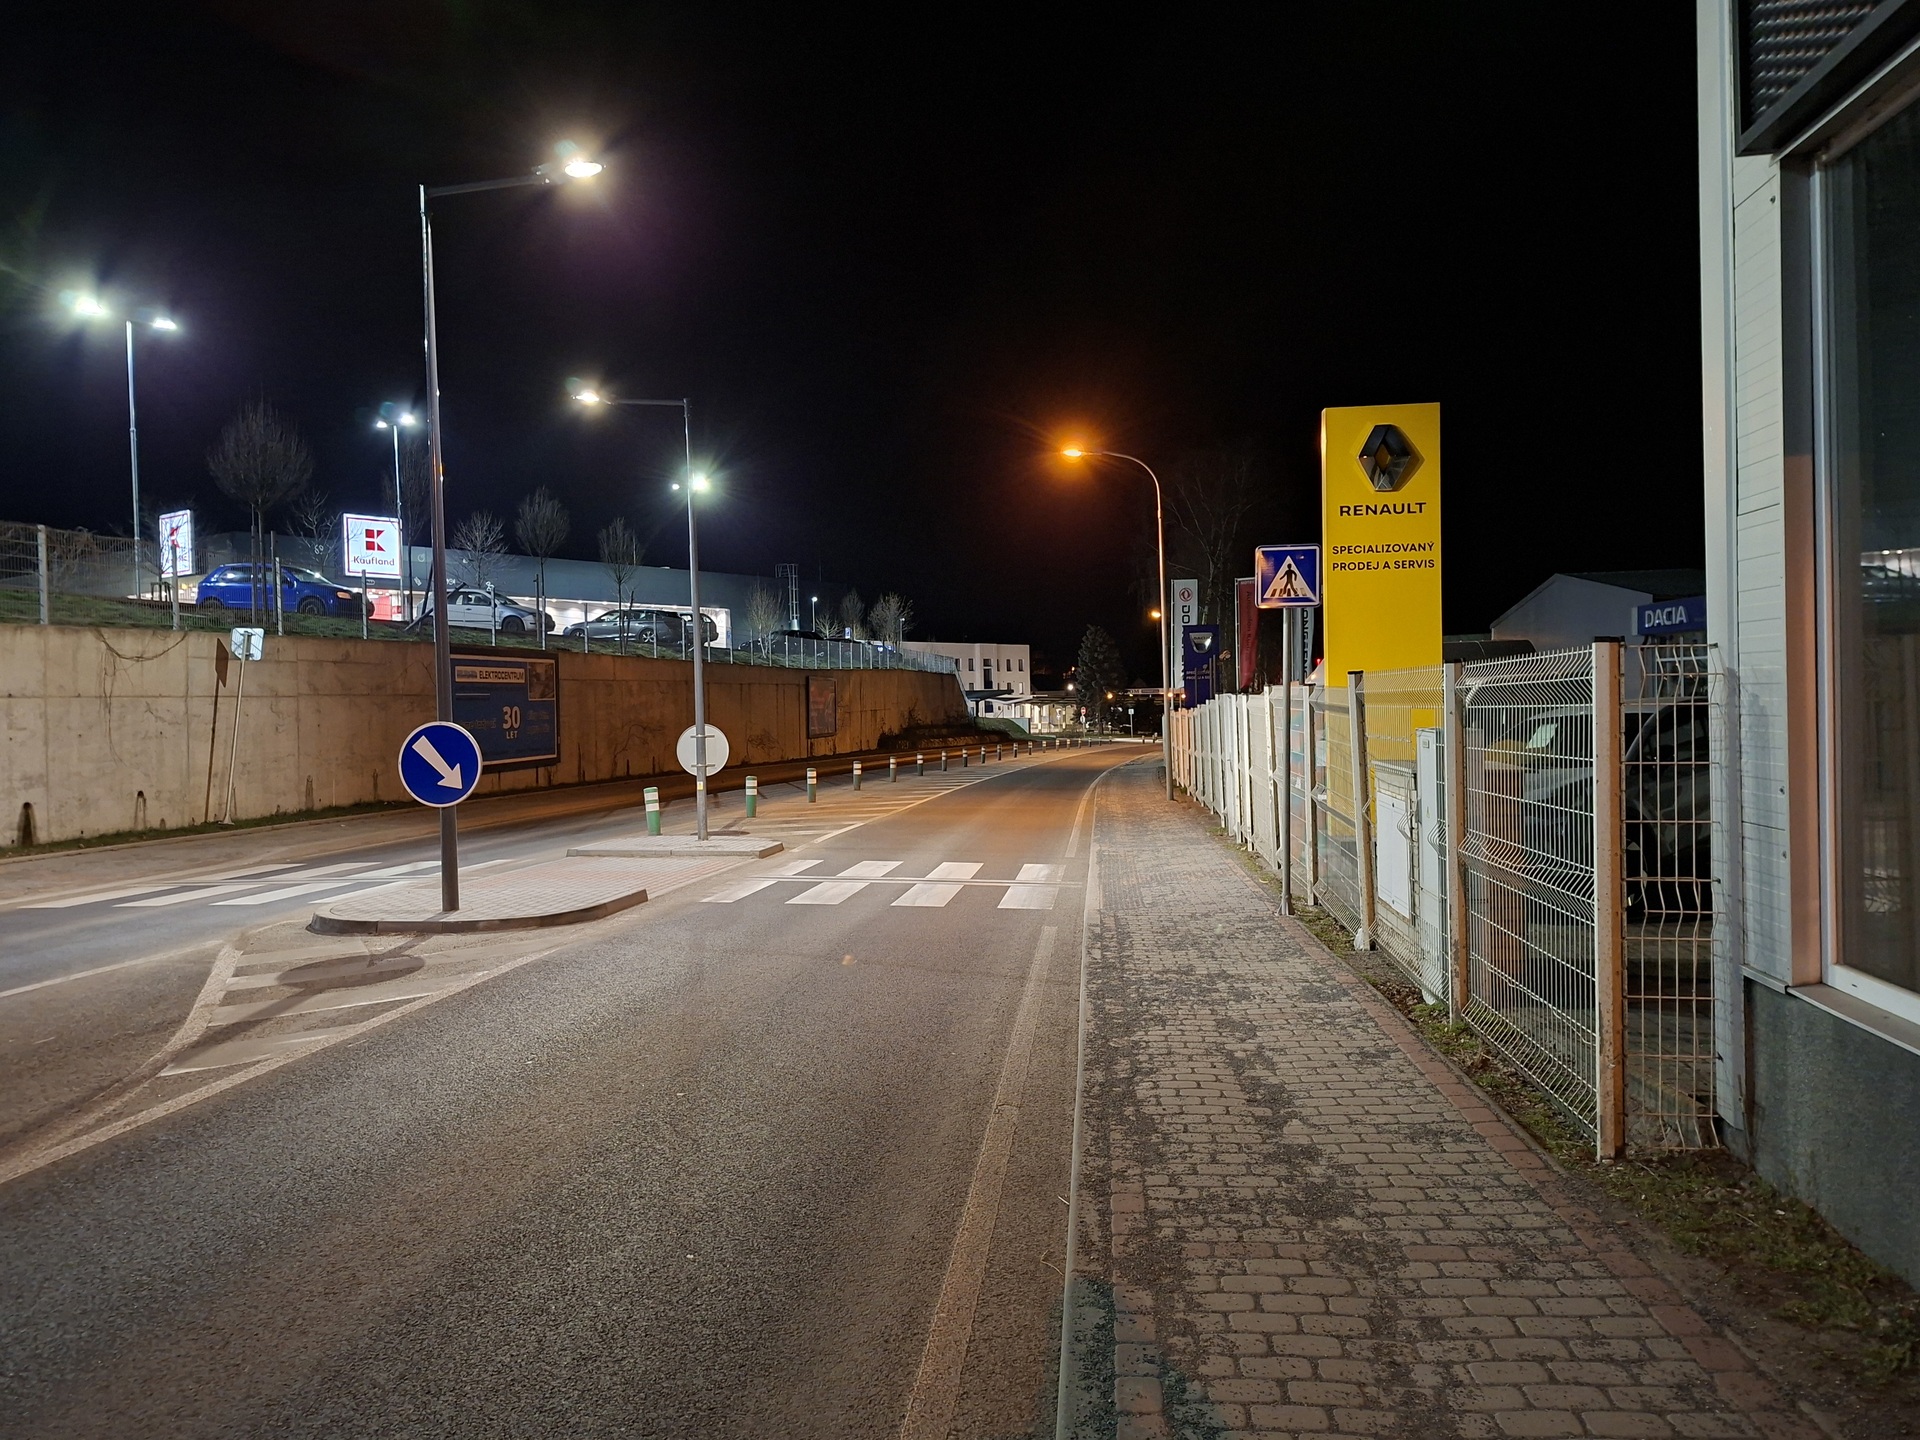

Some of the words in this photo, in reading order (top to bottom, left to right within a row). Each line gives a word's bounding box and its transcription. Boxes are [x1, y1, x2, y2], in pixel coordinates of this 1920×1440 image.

[1339, 502, 1427, 517] RENAULT
[1332, 541, 1435, 554] SPECIALIZOVANÝ
[353, 555, 395, 566] Kaufland
[1332, 561, 1380, 571] PRODEJ
[1382, 560, 1391, 570] A
[1393, 559, 1435, 569] SERVIS
[1644, 605, 1687, 628] DACIA
[479, 670, 524, 680] ELEKTROCENTRUM
[502, 705, 520, 729] 30
[506, 730, 518, 739] LET
